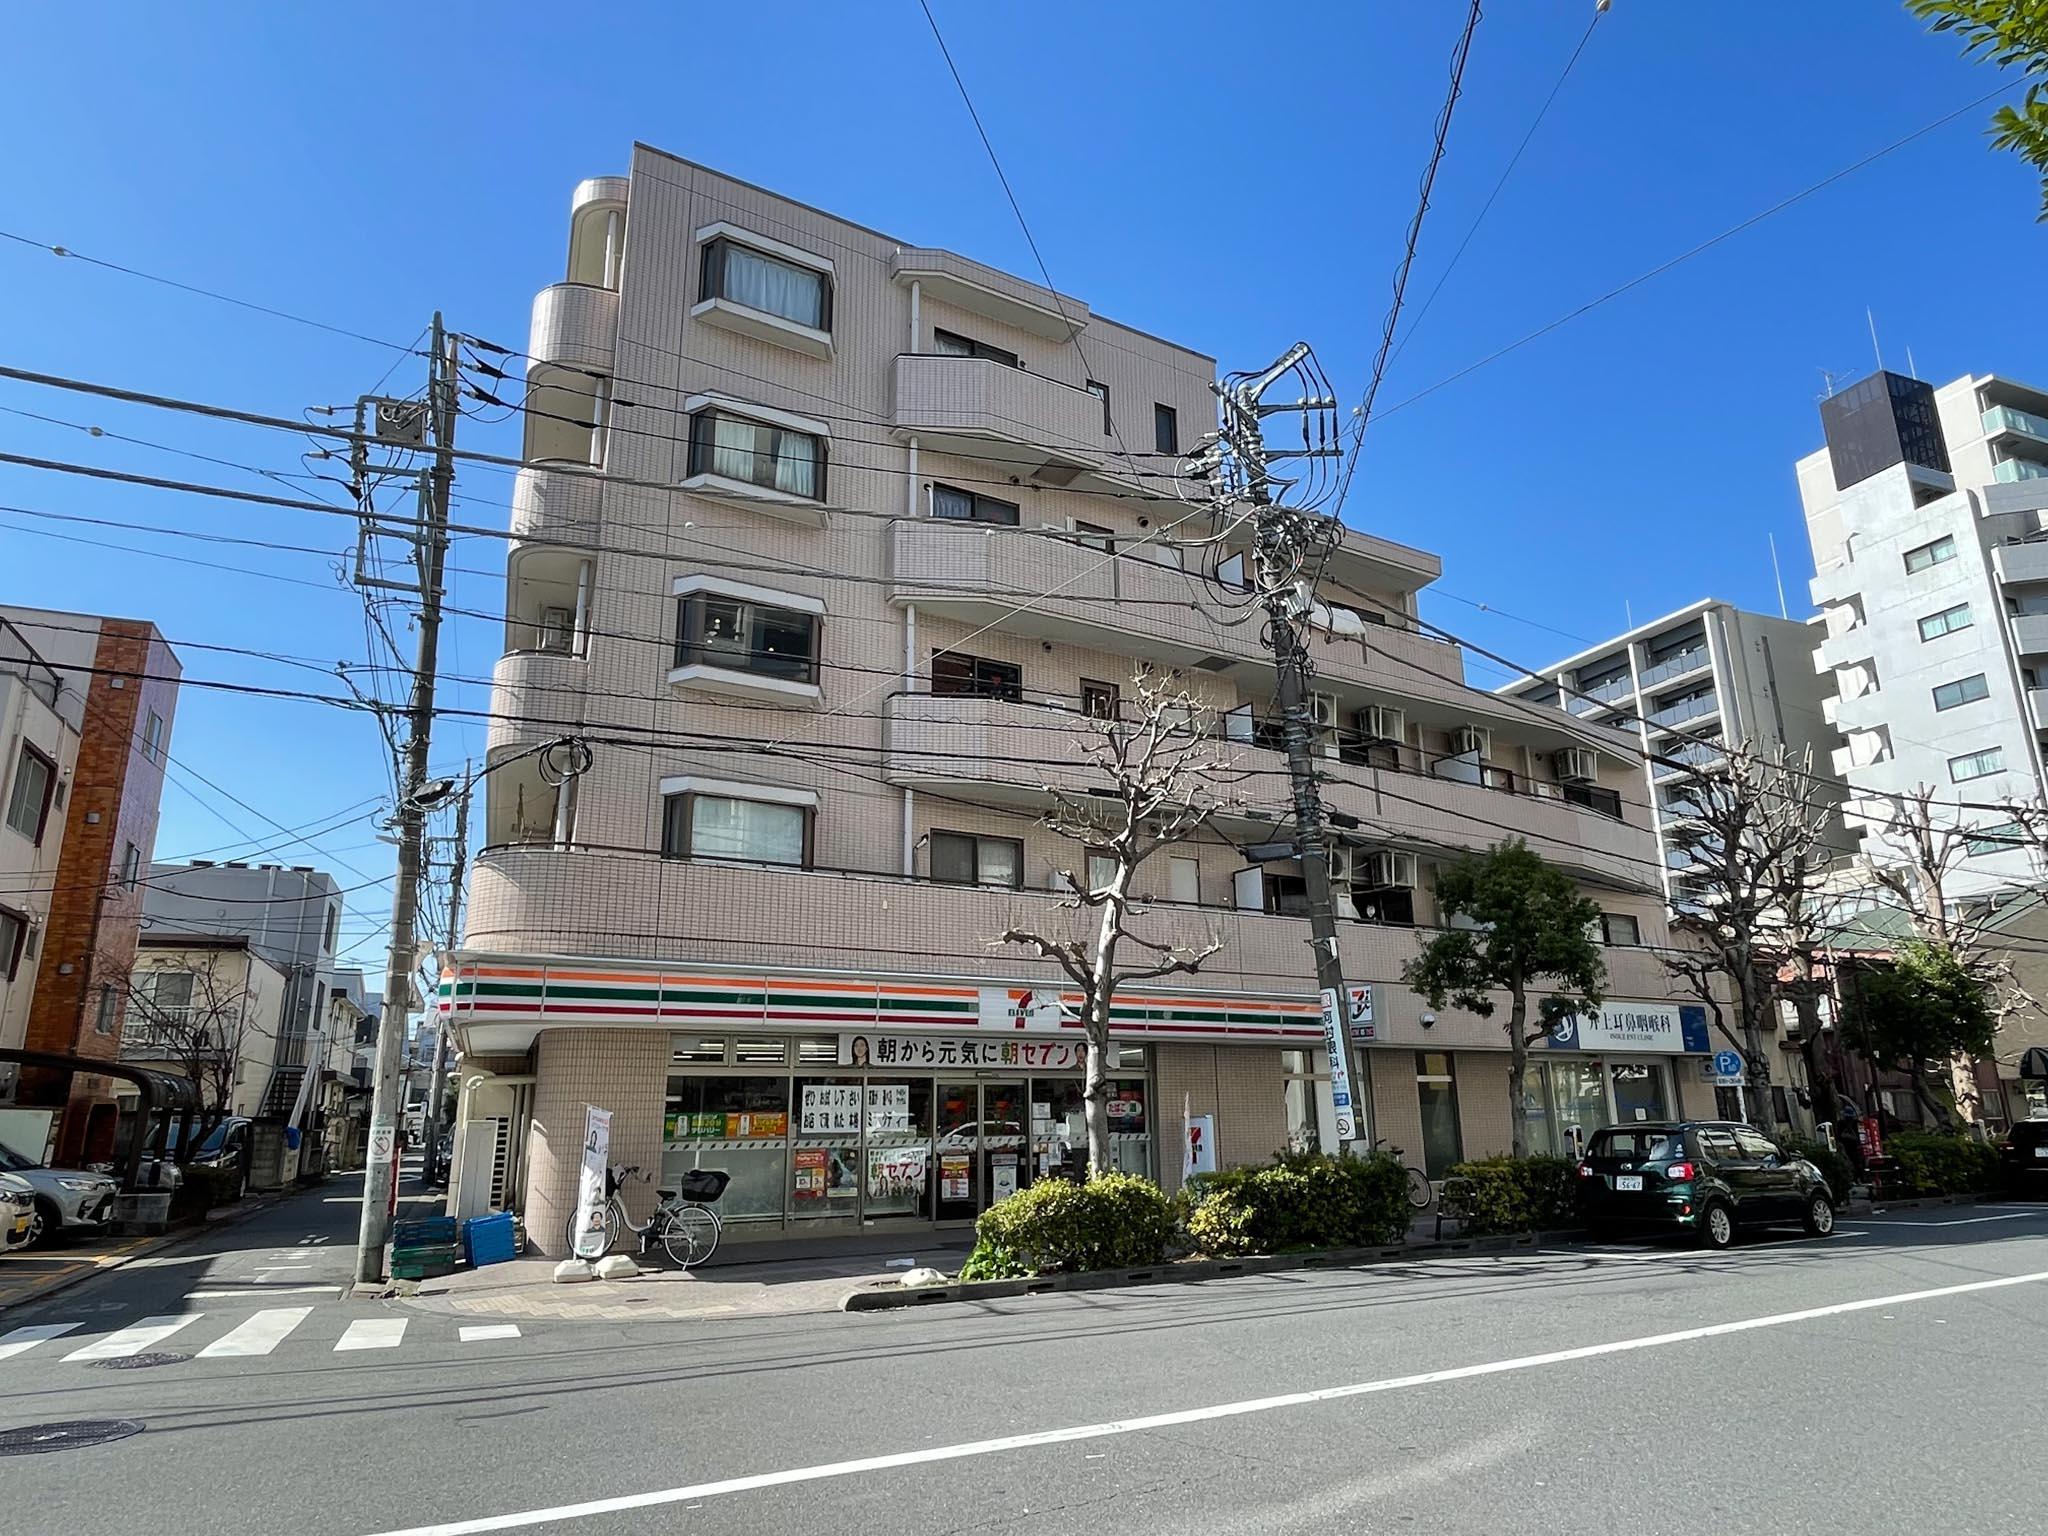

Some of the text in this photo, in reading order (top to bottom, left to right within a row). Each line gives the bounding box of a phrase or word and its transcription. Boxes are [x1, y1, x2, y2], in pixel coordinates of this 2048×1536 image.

[877, 1037, 1069, 1065] 朝から元気に朝セブン
